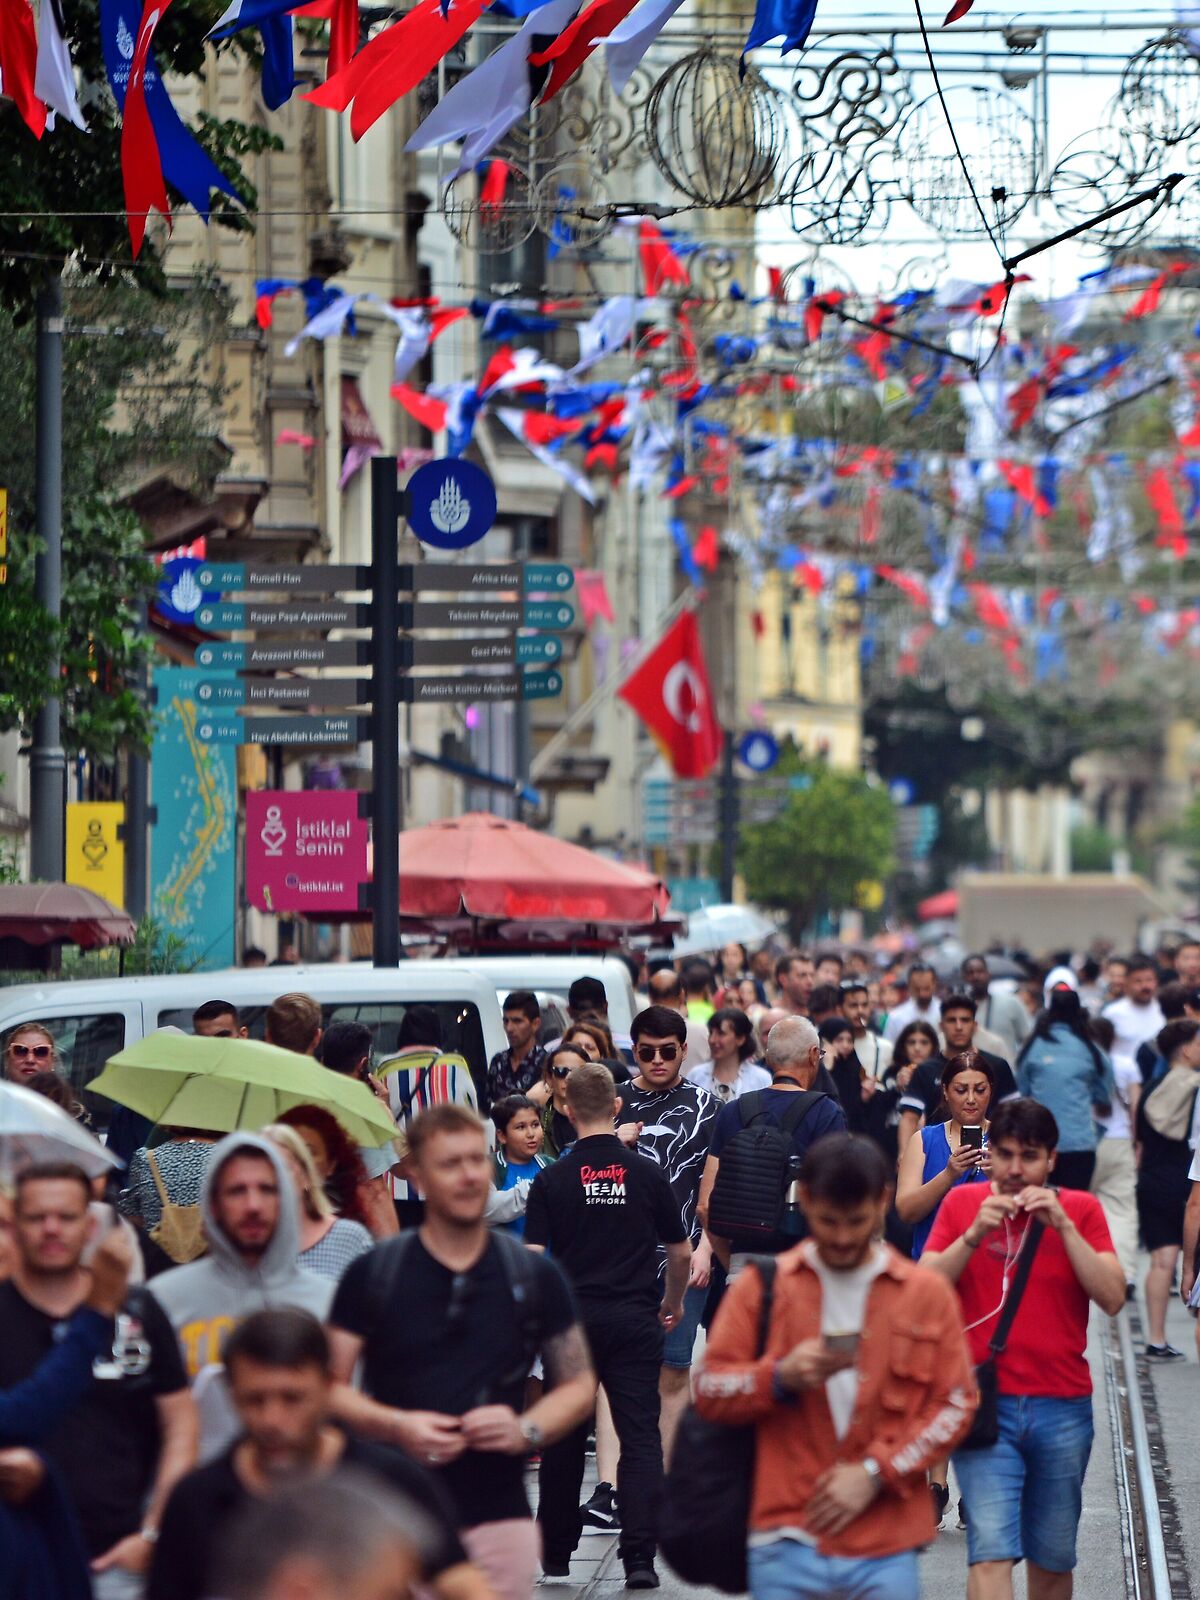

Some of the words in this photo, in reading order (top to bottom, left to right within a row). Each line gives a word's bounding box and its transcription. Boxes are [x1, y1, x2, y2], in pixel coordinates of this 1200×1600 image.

[233, 575, 241, 583] m
[250, 573, 281, 584] Rumeli
[282, 573, 302, 584] Han
[472, 573, 498, 584] Afrika
[500, 573, 518, 584] Han
[233, 614, 242, 622] m
[448, 610, 478, 621] Taksim
[480, 610, 519, 623] Meydanı
[233, 653, 242, 661] m
[293, 649, 324, 660] Kilisesi
[471, 647, 490, 658] Gezi
[233, 689, 242, 697] m
[268, 687, 310, 698] Pastanesi
[420, 684, 453, 695] Atatürk
[484, 683, 517, 693] Merkezi
[325, 720, 348, 730] Tarihi
[229, 728, 237, 736] m
[271, 731, 308, 742] Abdullah
[309, 731, 348, 741] Lokantası
[296, 816, 351, 839] İstiklal
[295, 839, 344, 856] Senin
[298, 881, 344, 893] istiklal.ist
[580, 1164, 628, 1184] Beauty
[583, 1183, 626, 1196] TEAM
[585, 1197, 626, 1205] SEPHORA
